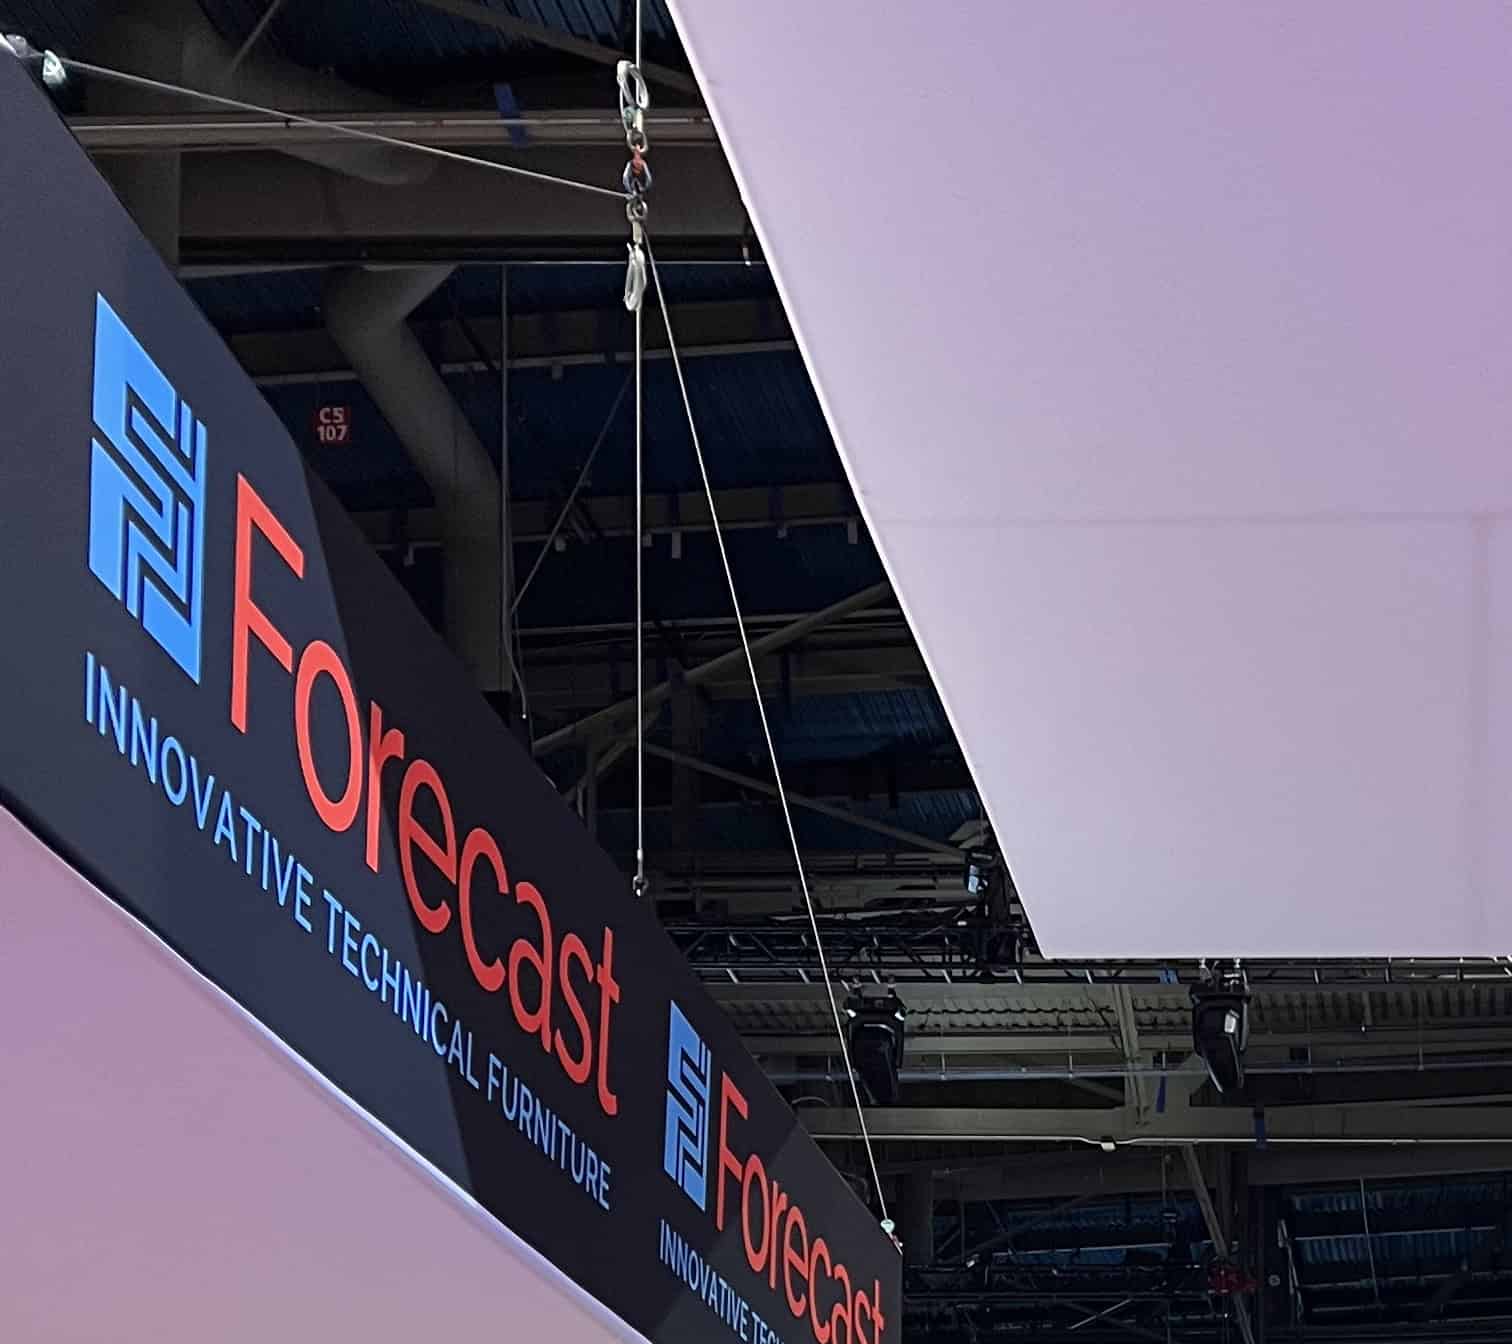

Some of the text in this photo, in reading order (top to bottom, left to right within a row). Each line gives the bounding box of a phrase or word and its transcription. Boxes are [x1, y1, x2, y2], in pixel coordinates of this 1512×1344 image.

[317, 425, 347, 441] 107
[320, 407, 344, 423] C5
[231, 472, 619, 1115] Forecast
[85, 651, 611, 1210] INNOVATIVE TECHNICAL FURNITURE
[660, 1219, 748, 1342] INNOVATIVE
